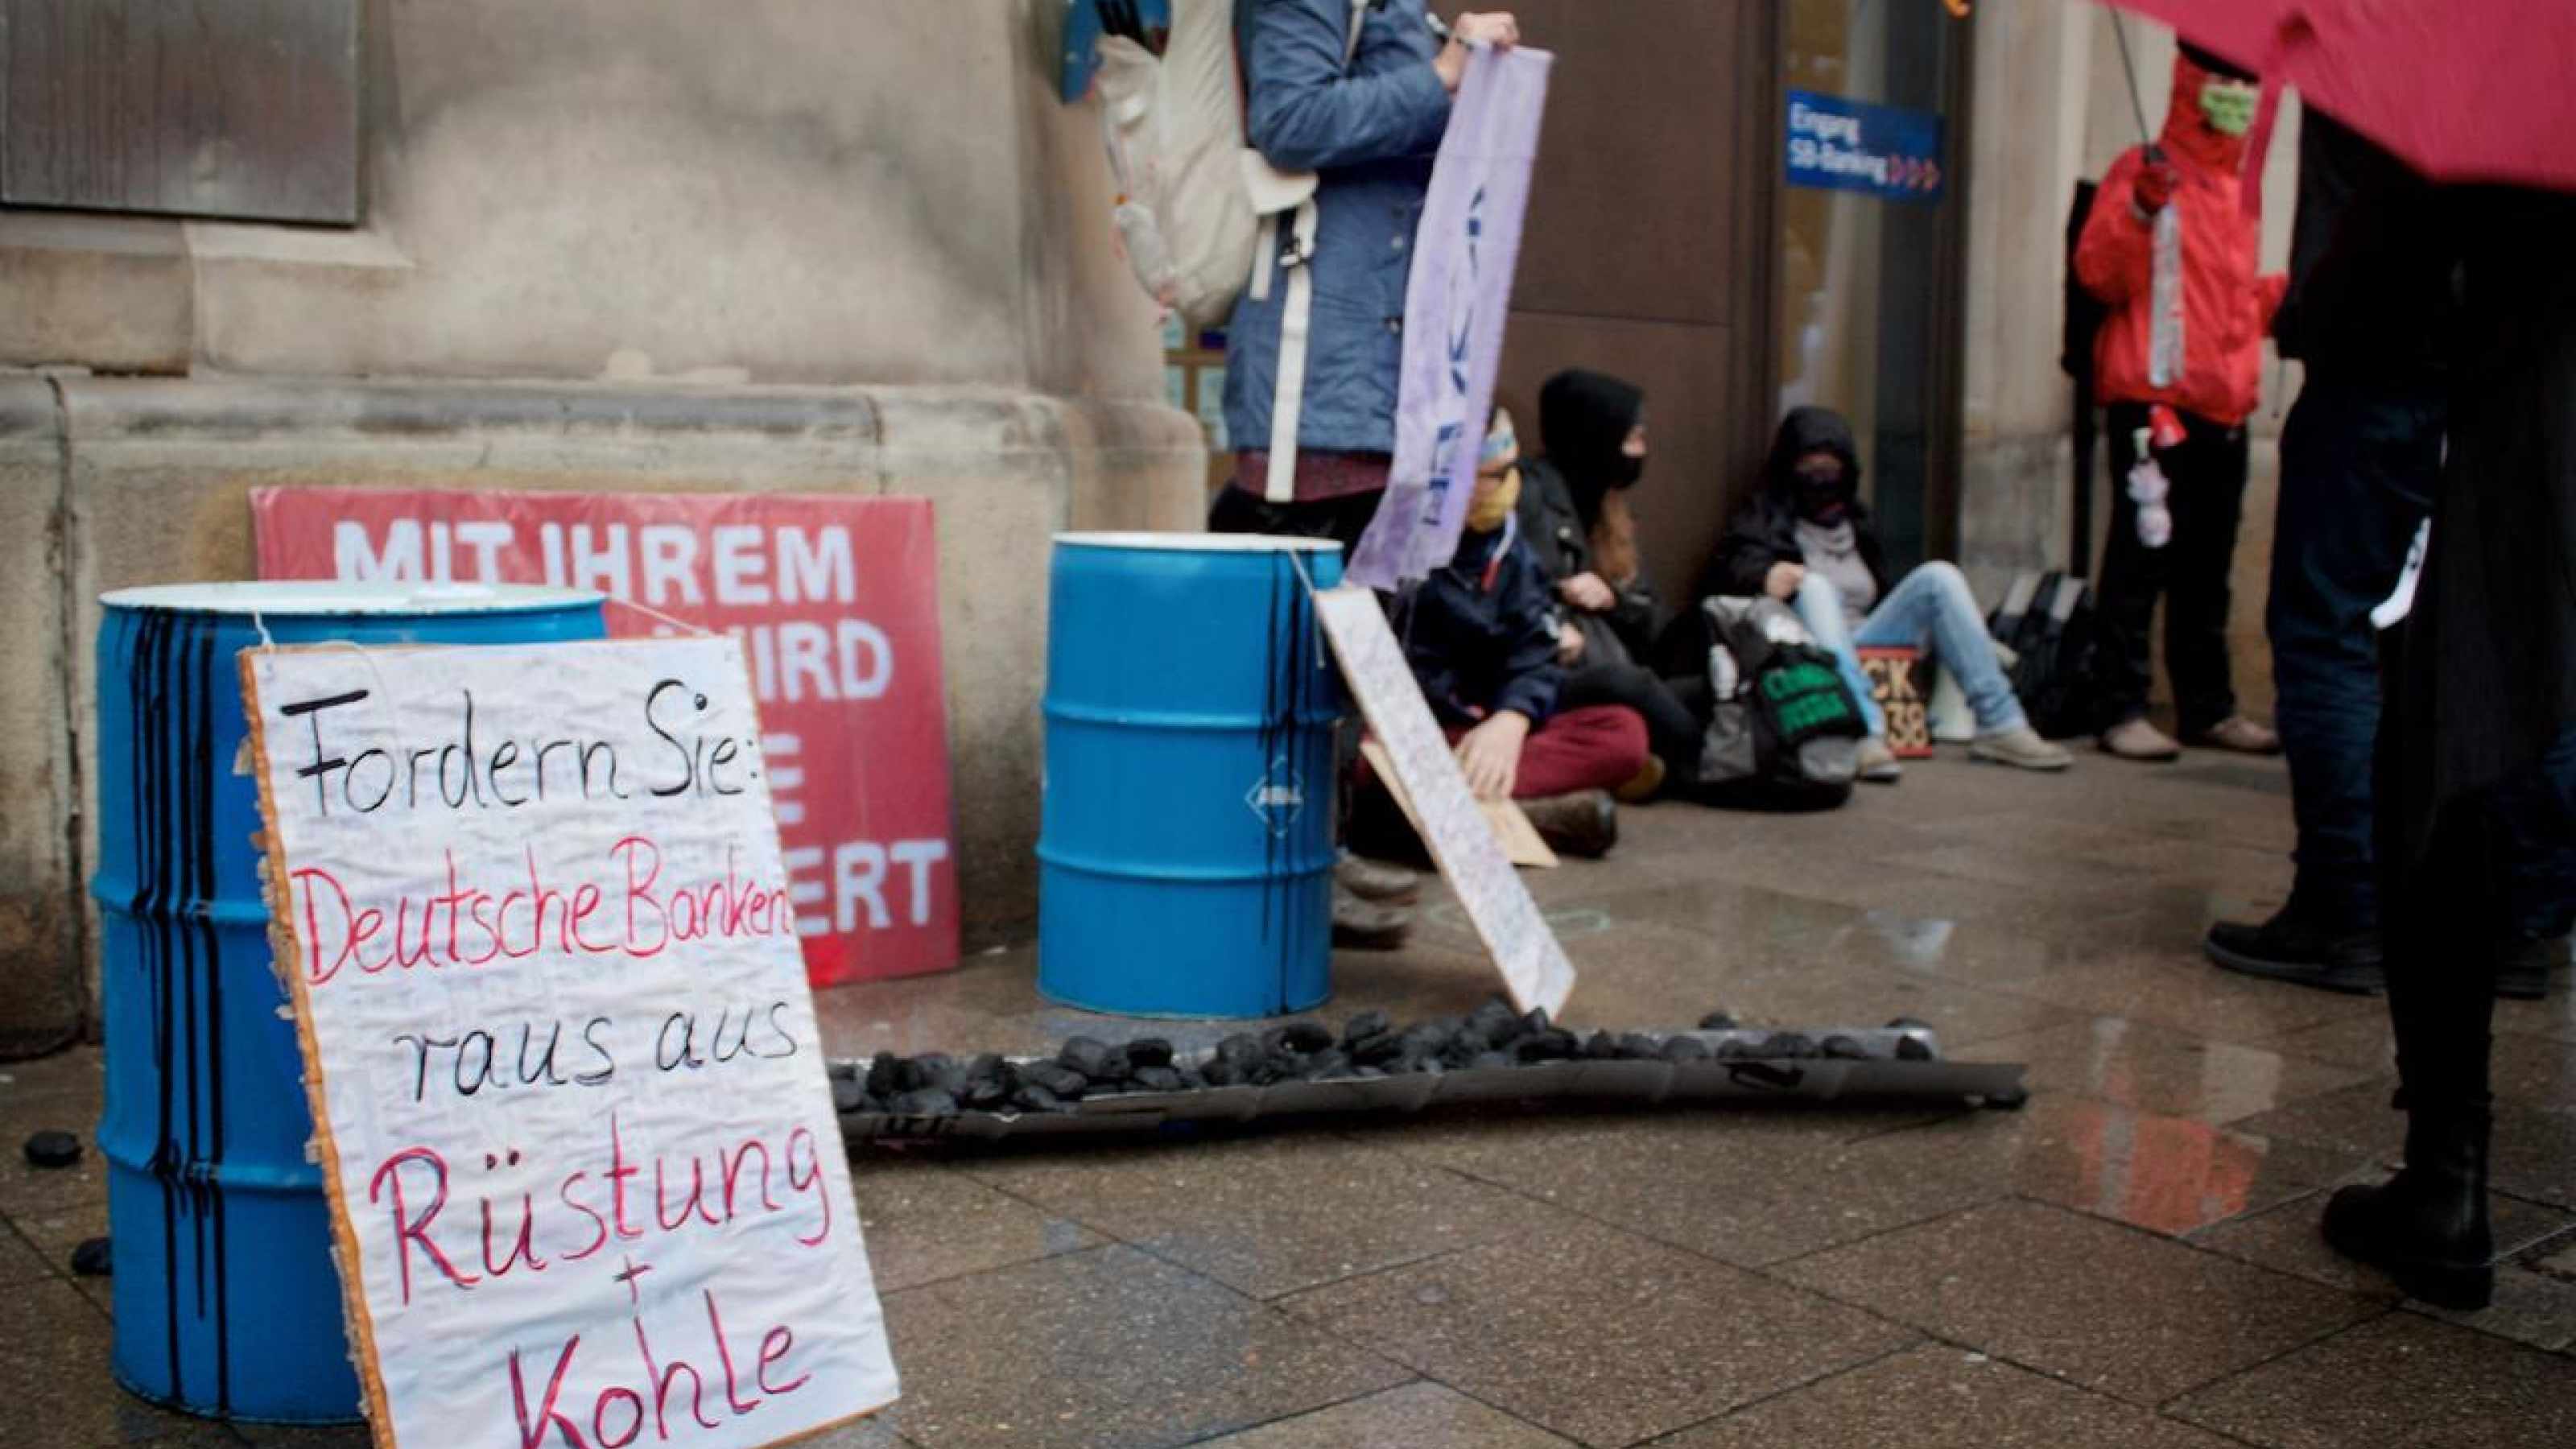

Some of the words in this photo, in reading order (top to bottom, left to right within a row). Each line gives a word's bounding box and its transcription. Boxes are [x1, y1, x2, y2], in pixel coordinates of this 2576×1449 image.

[334, 519, 514, 584] MIT
[541, 523, 855, 605] IHREM
[652, 620, 894, 702] IRD
[280, 688, 630, 816] Fordern
[646, 678, 758, 799] Sie:
[291, 843, 618, 985] Deutsche
[609, 836, 792, 958] Banken
[393, 1017, 616, 1102] raus
[657, 1001, 798, 1071] aus
[369, 1111, 832, 1306] Rüstung
[509, 1288, 812, 1449] Kohle
